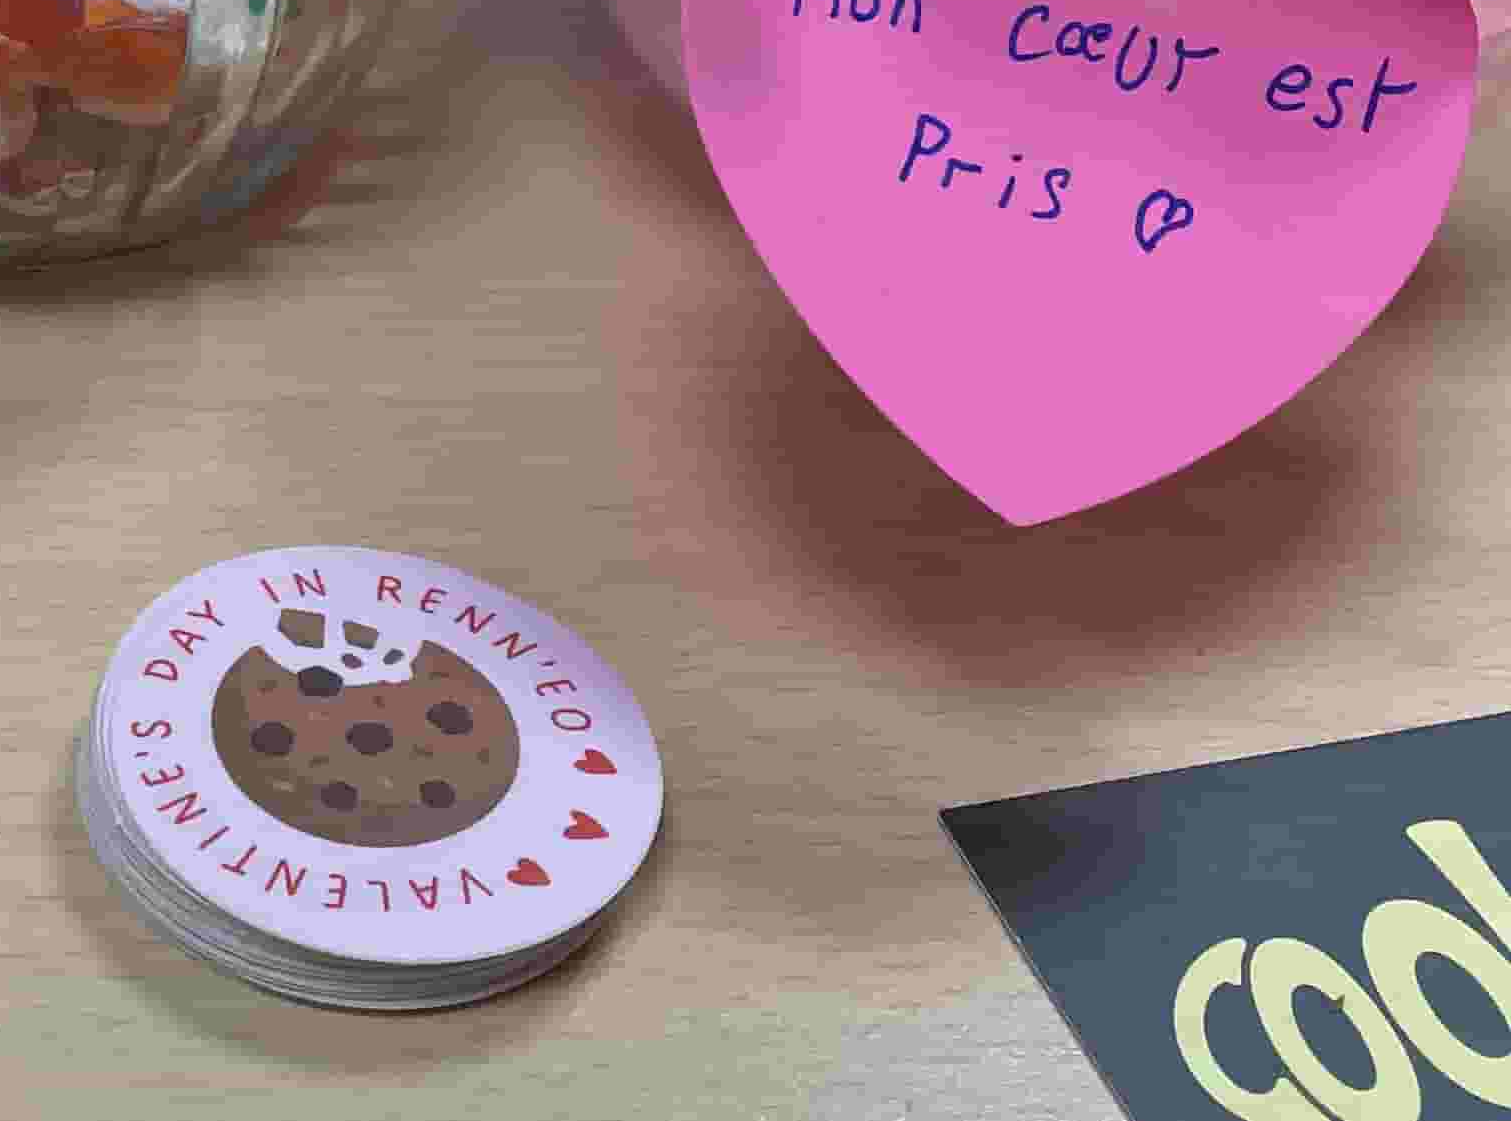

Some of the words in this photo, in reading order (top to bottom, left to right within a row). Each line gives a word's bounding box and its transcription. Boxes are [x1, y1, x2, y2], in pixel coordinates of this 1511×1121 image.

[1264, 57, 1417, 133] est
[257, 568, 326, 604] IN
[144, 599, 225, 681] DAY
[376, 575, 592, 731] RENN'EO
[130, 718, 494, 911] VALENTINE'S
